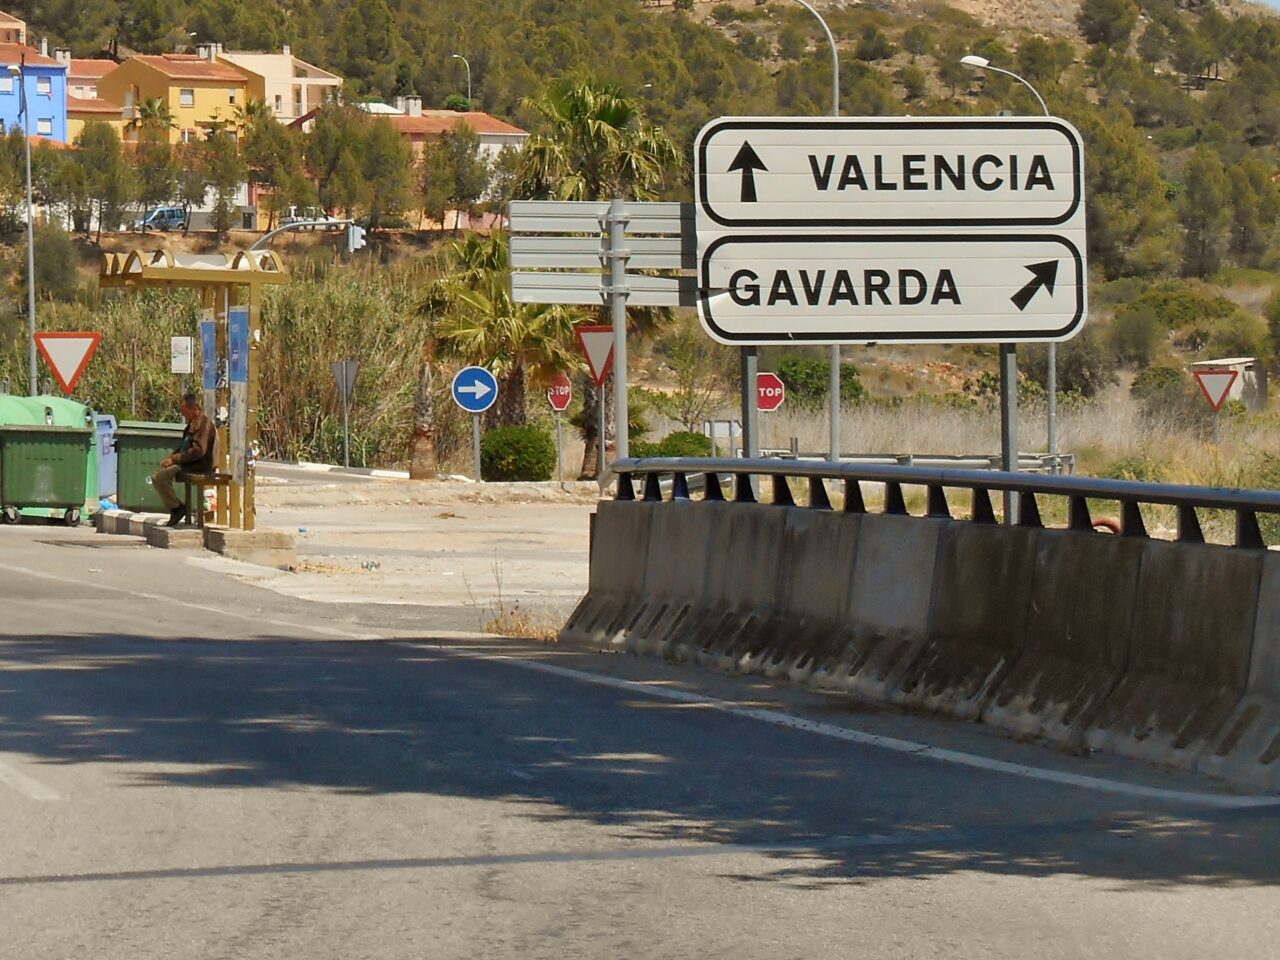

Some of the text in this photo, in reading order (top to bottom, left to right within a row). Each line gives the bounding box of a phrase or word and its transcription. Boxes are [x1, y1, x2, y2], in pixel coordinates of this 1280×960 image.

[808, 154, 1055, 191] VALENCIA
[728, 269, 962, 306] GAVARDA
[758, 387, 782, 397] TOP
